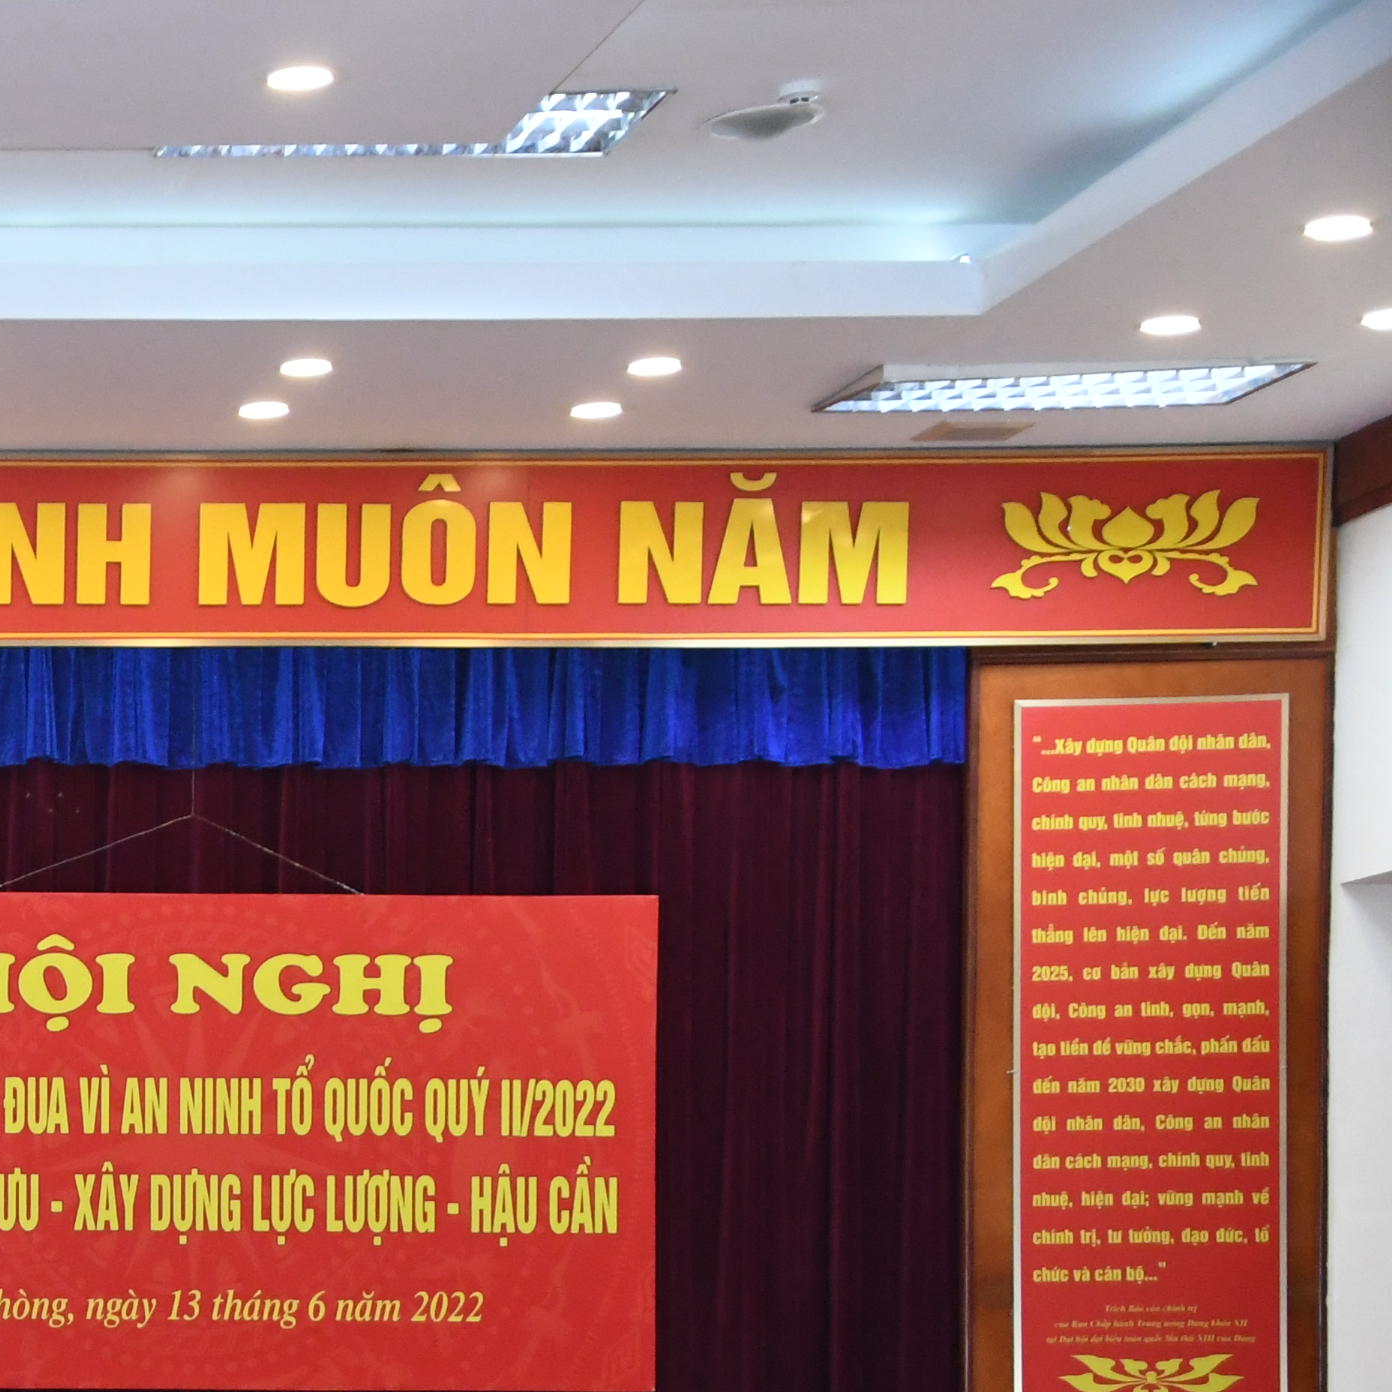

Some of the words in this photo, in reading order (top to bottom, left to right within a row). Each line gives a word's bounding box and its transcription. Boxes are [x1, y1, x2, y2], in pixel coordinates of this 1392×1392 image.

[199, 473, 573, 608] MUÔN
[618, 472, 910, 607] NĂM
[1086, 738, 1123, 756] dựng
[1127, 736, 1165, 754] Quân
[1197, 734, 1234, 750] nhân
[1239, 733, 1270, 748] dân,
[1032, 777, 1070, 794] Công
[1077, 778, 1095, 792] an
[1102, 775, 1138, 790] nhân
[1145, 774, 1173, 789] dân
[1180, 773, 1216, 788] cách
[1032, 966, 1073, 982] 2025,
[1148, 963, 1174, 980] xây
[1185, 964, 1221, 980] dựng
[1232, 962, 1269, 978] Quân
[169, 954, 453, 1033] NGHỊ
[1068, 1003, 1106, 1019] Công
[1114, 1004, 1132, 1017] an
[1068, 1078, 1100, 1093] năm
[1108, 1077, 1145, 1092] 2030
[1153, 1076, 1179, 1093] xây
[1188, 1076, 1224, 1094] dựng
[1232, 1076, 1270, 1092] Quân
[4, 1077, 68, 1134] ĐUA
[80, 1065, 109, 1134] VÌ
[122, 1078, 167, 1134] AN
[180, 1078, 261, 1134] NINH
[273, 1054, 314, 1135] TỔ
[325, 1058, 412, 1142] QUỐC
[425, 1067, 489, 1142] QUÝ
[501, 1079, 615, 1137] II/2022
[1066, 1116, 1102, 1131] nhân
[1114, 1115, 1144, 1131] dân,
[1156, 1114, 1193, 1131] Công
[1204, 1117, 1222, 1128] an
[1233, 1114, 1269, 1128] nhân
[1033, 1154, 1060, 1169] dân
[1065, 1154, 1102, 1168] cách
[1206, 1155, 1234, 1168] quy,
[74, 1162, 138, 1230] XÂY
[151, 1168, 240, 1244] DỰNG
[254, 1169, 314, 1244] LỰC
[327, 1170, 435, 1245] LƯỢNG
[471, 1164, 537, 1246] HẬU
[550, 1156, 617, 1234] CẦN
[86, 1290, 156, 1328] ngày
[168, 1290, 201, 1320] 13
[212, 1290, 299, 1328] tháng
[308, 1291, 325, 1321] 6
[336, 1291, 400, 1321] năm
[411, 1292, 483, 1322] 2022
